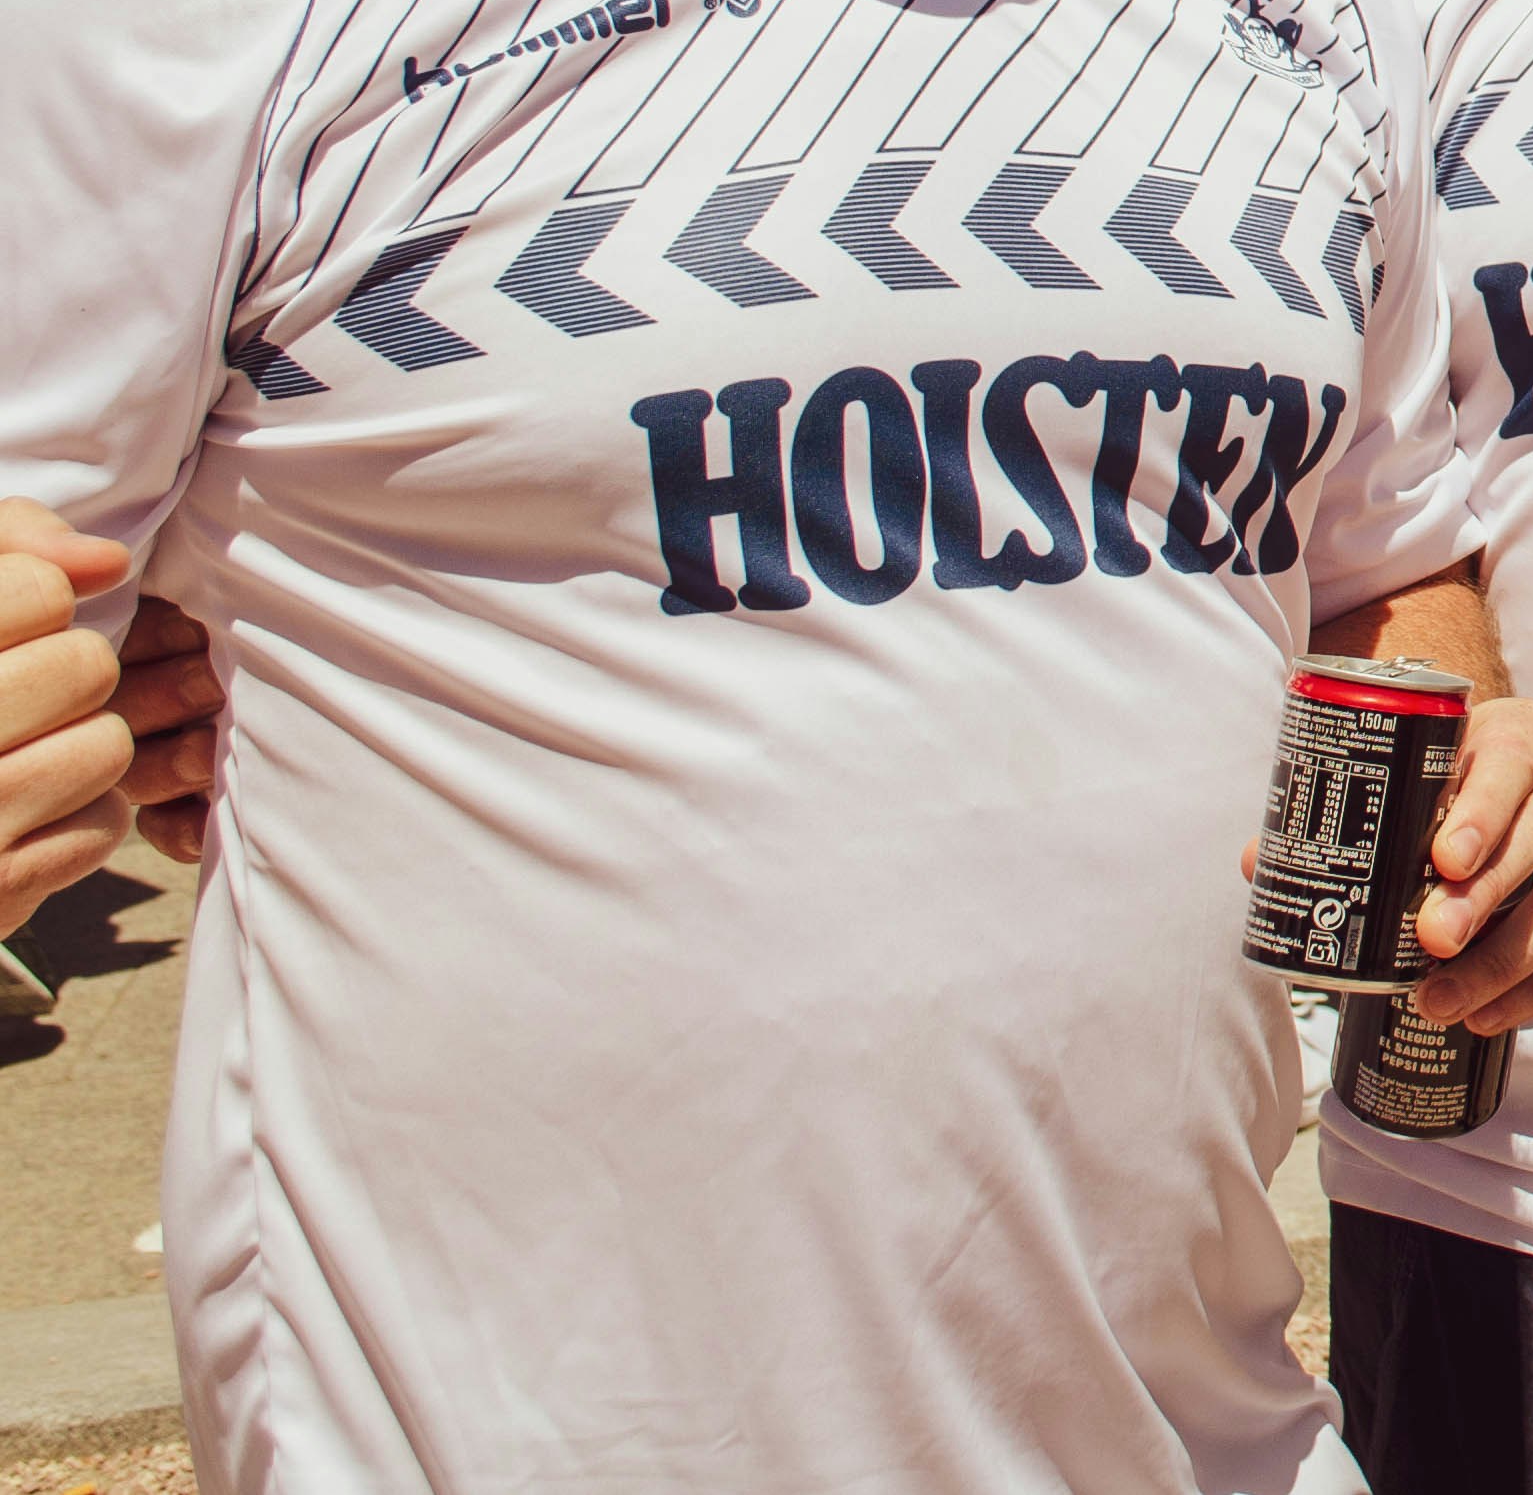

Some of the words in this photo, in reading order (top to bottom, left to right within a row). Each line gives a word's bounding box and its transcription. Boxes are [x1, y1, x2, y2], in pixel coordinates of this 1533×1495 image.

[629, 349, 1348, 617] HOLSTEN
[1360, 711, 1382, 731] 150
[1382, 715, 1398, 733] ml
[1425, 750, 1445, 760] RETO
[1391, 995, 1403, 1009] EL
[1379, 1035, 1391, 1050] EL
[1394, 1042, 1438, 1060] SABOR
[1440, 1049, 1457, 1060] DE
[1393, 1027, 1446, 1047] ELEGIDO
[1382, 1052, 1418, 1072] PEPSI
[1420, 1063, 1449, 1074] MAX
